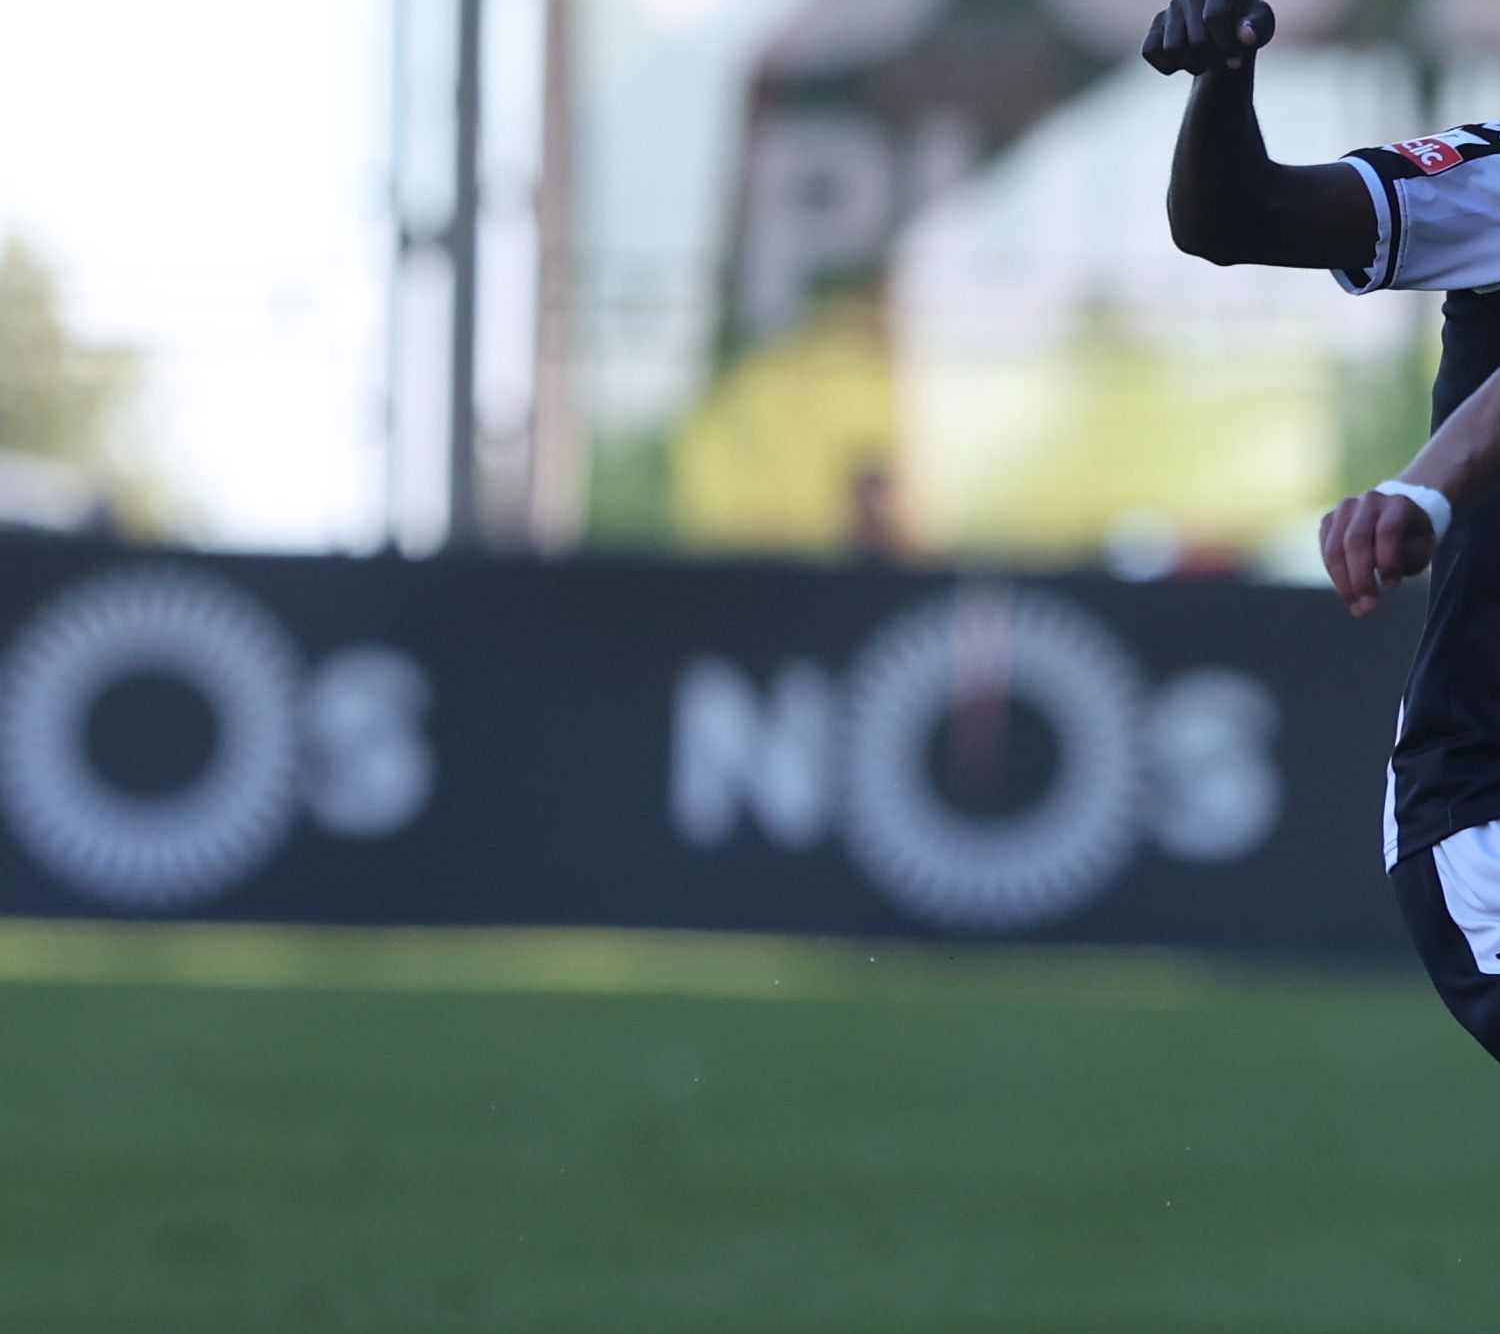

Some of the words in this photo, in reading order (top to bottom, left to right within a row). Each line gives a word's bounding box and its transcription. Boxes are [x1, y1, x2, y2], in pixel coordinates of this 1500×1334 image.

[1401, 141, 1443, 166] clic
[0, 560, 435, 910] OS
[668, 582, 1284, 935] NOS
